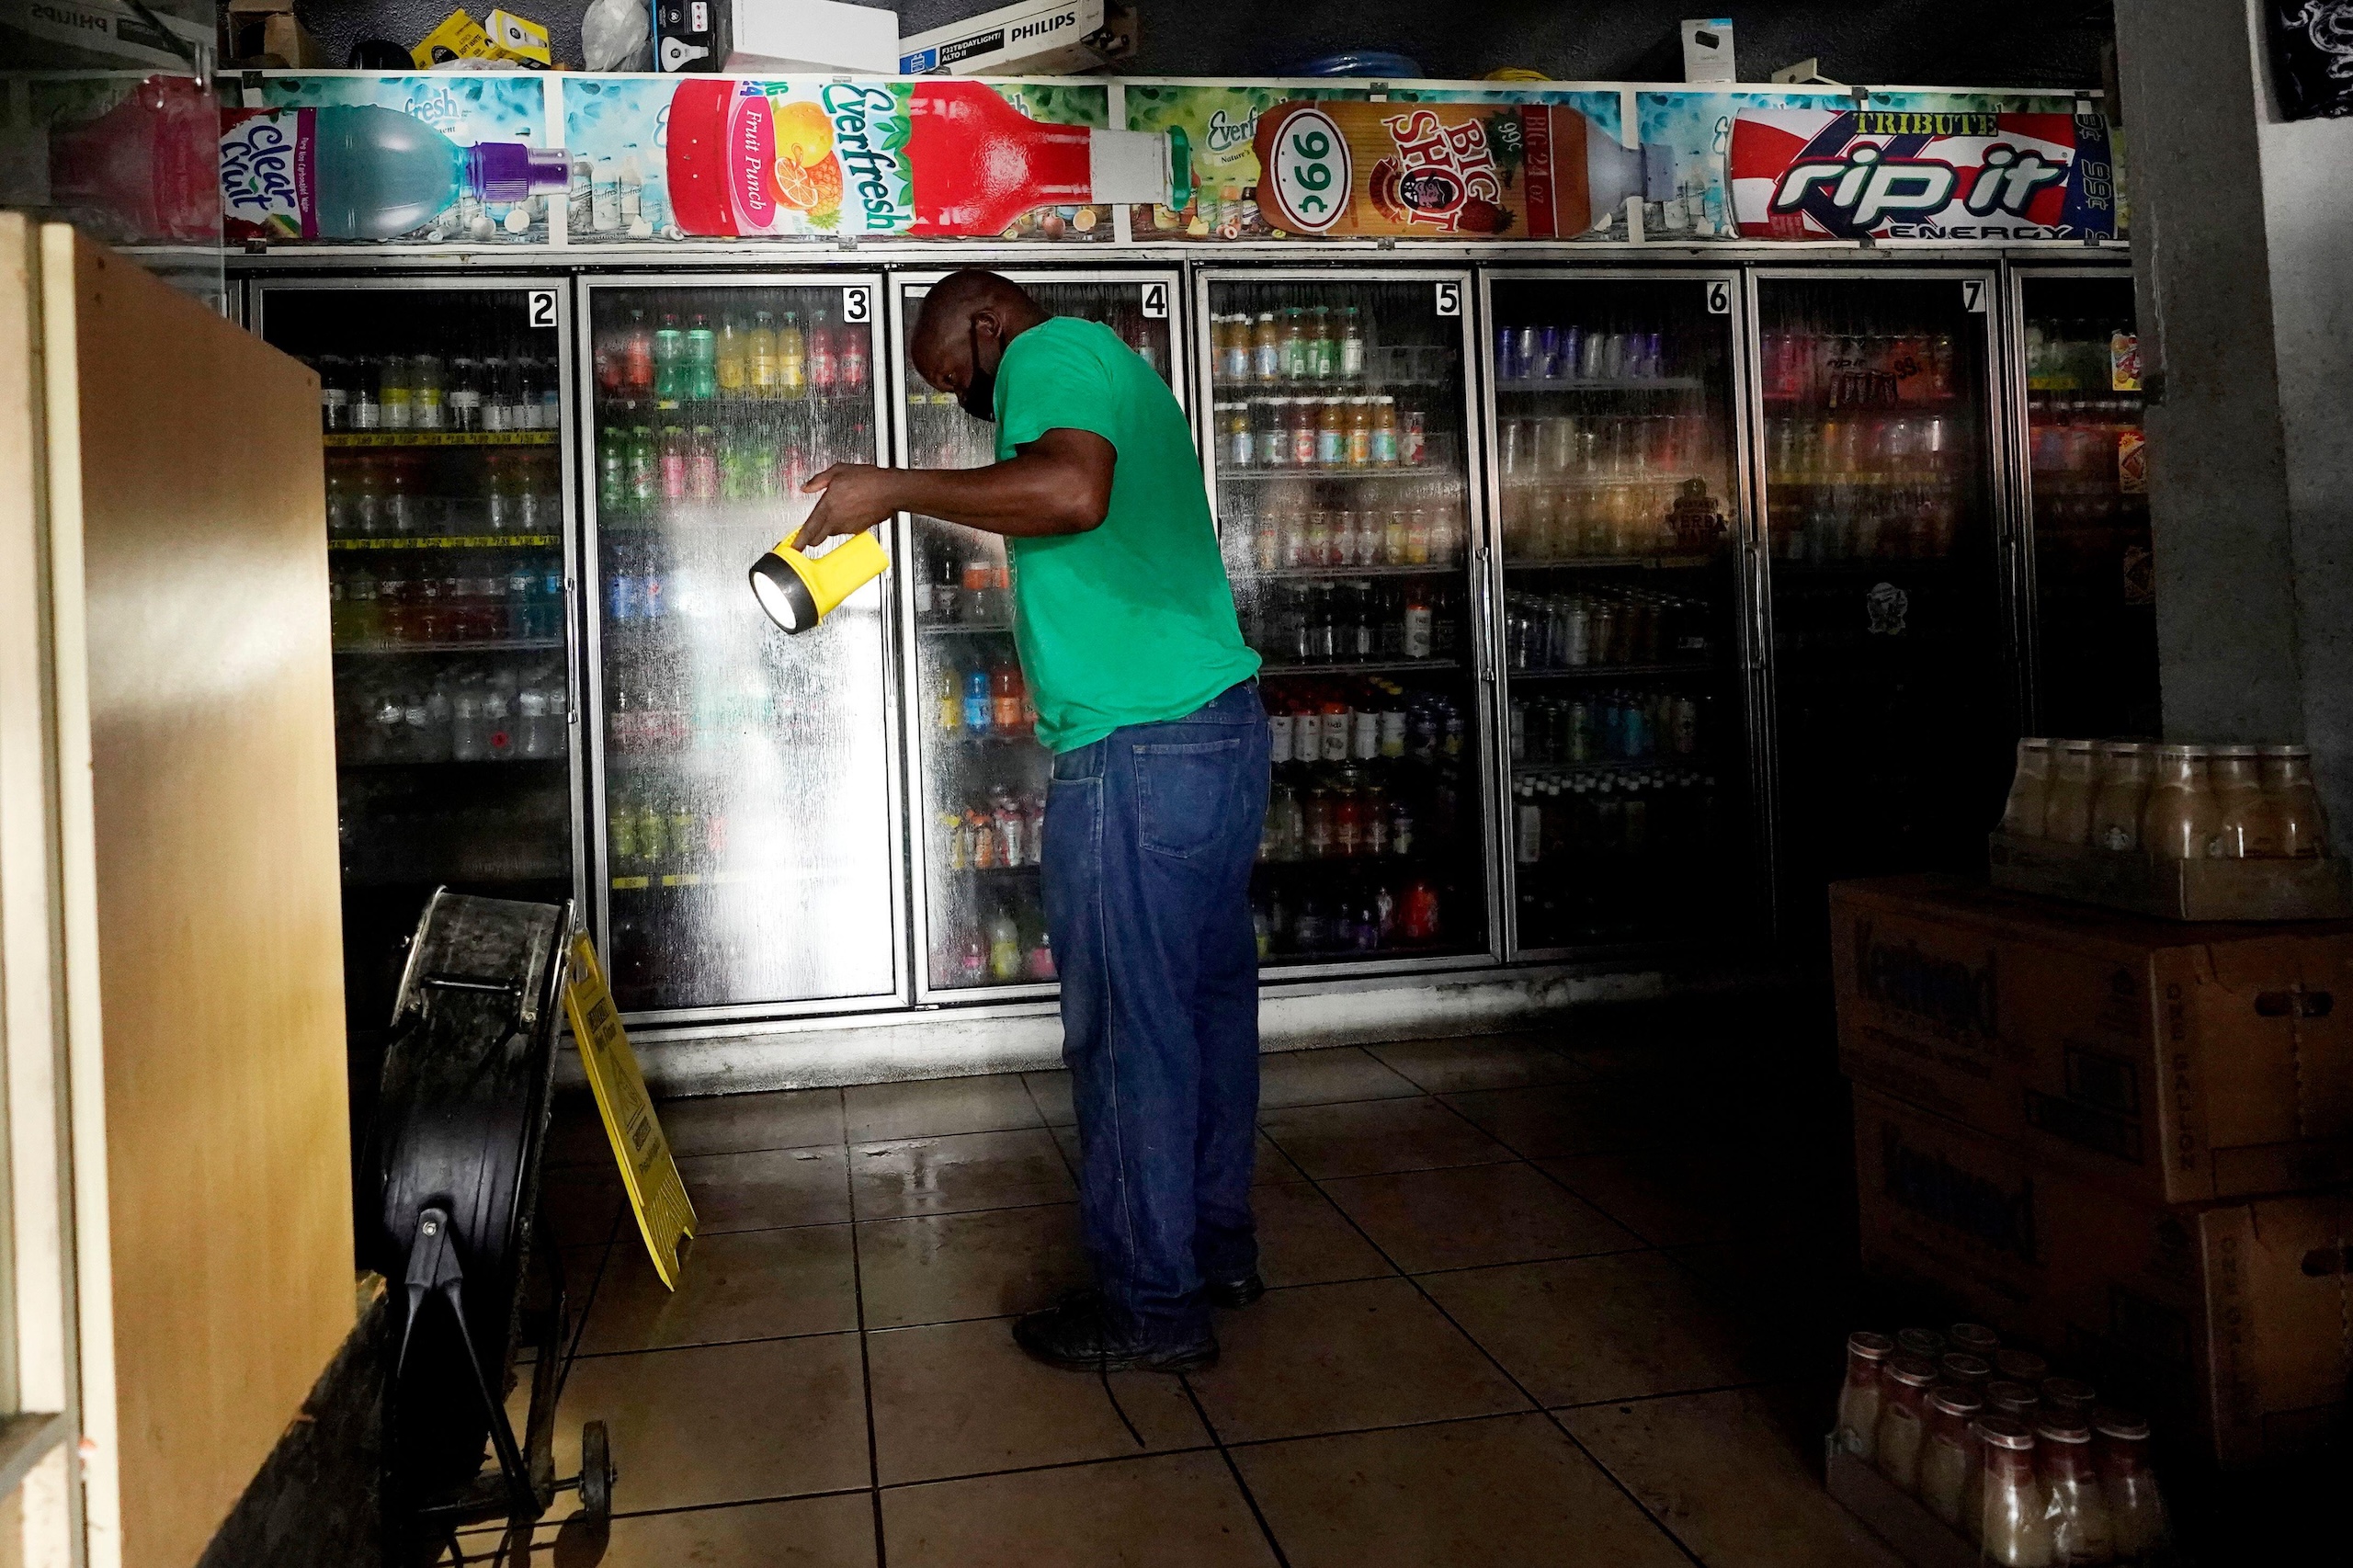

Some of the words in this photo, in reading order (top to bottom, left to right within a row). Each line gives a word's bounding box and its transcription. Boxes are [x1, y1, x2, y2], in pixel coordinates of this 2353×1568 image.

[1011, 12, 1075, 42] PHILIPS
[942, 52, 961, 62] ALTO
[745, 110, 762, 153] Fruit
[1208, 107, 1259, 152] Everf
[1526, 117, 1548, 146] BIG
[1853, 112, 1997, 136] TRIBUTE
[823, 84, 912, 230] Everfresh
[1221, 149, 1251, 164] Nature's
[1443, 119, 1500, 204] BIG
[1528, 153, 1549, 176] 24
[745, 155, 767, 210] Punch
[1292, 131, 1332, 213] 99¢
[1381, 110, 1467, 233] SHOT
[1774, 145, 1957, 227] rip
[1966, 145, 2065, 214] it
[2081, 158, 2112, 210] 99¢
[1889, 222, 2073, 239] ENERGY
[534, 294, 553, 324] 2
[847, 290, 867, 319] 3
[1145, 285, 1165, 314] 4
[1440, 285, 1457, 312] 5
[1711, 284, 1726, 312] 6
[1966, 282, 1981, 310] 7
